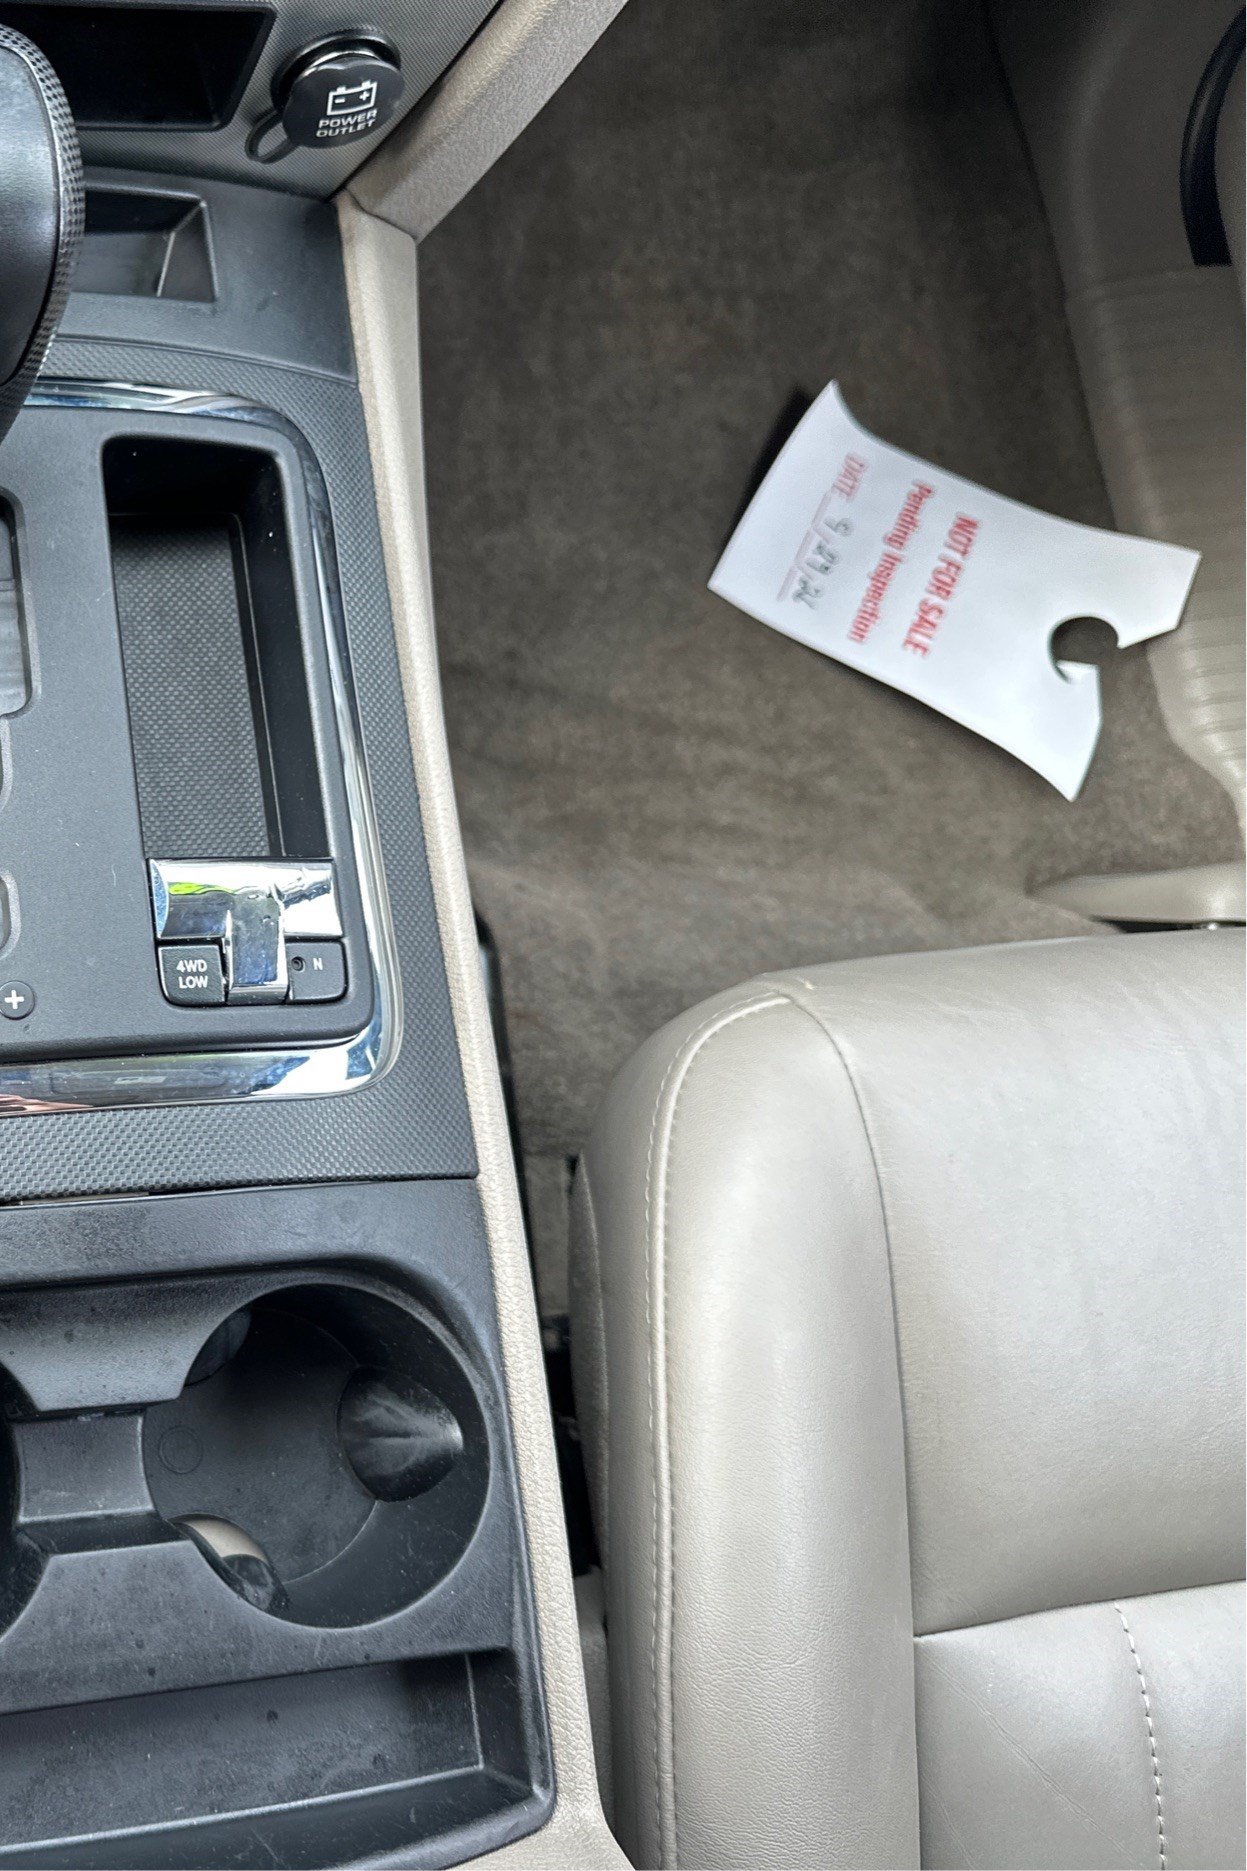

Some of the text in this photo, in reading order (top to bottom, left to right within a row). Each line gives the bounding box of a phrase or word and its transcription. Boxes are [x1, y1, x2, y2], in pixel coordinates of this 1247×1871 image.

[316, 119, 376, 138] OUTLET
[318, 109, 377, 129] POWER
[847, 480, 934, 644] Pending Inspection
[903, 512, 980, 658] NOT FOR SALE
[176, 959, 208, 972] 4WD
[313, 957, 324, 971] N
[178, 975, 209, 989] LOW
